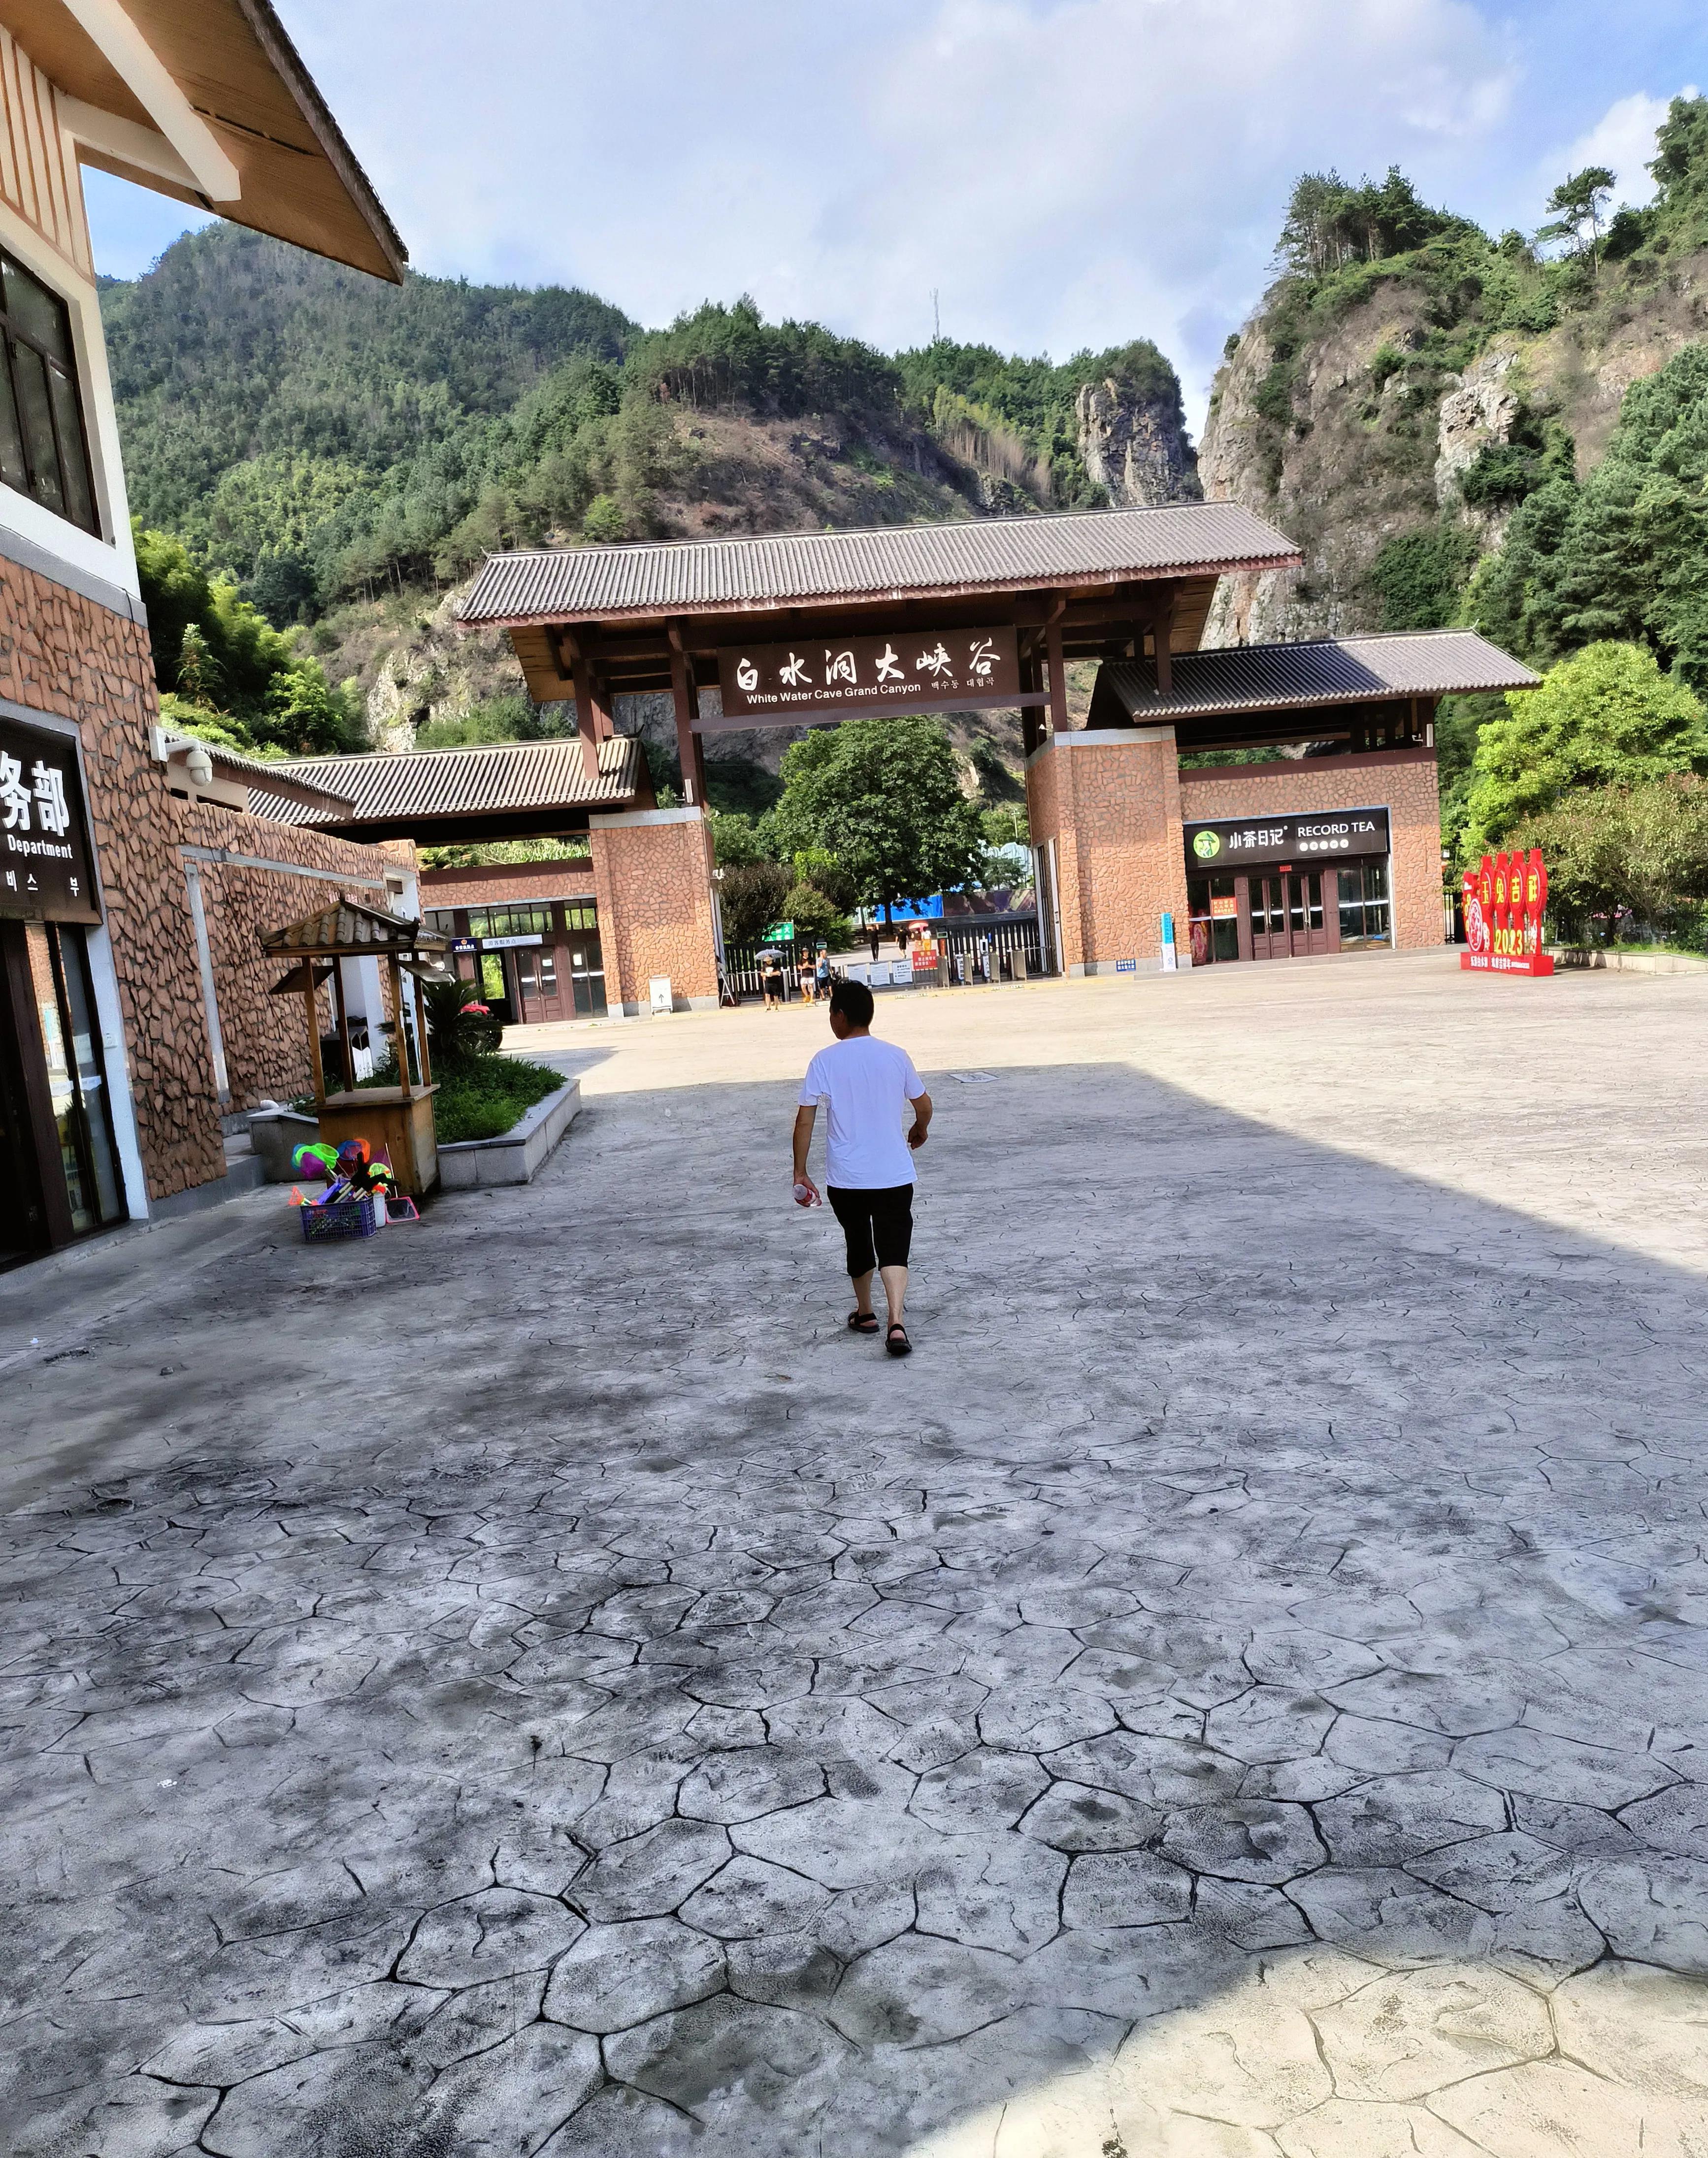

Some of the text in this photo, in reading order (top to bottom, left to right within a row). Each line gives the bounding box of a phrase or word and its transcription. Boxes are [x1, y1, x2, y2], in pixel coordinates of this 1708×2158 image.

[737, 637, 1001, 691] 白水洞大峡谷
[746, 684, 921, 704] White Water Cave Grand Canyon
[931, 679, 959, 690] 백수동
[1229, 829, 1284, 849] 小茶日记
[1298, 821, 1376, 837] RECORD TEA
[7, 833, 73, 859] Department
[1494, 929, 1523, 956] 2023
